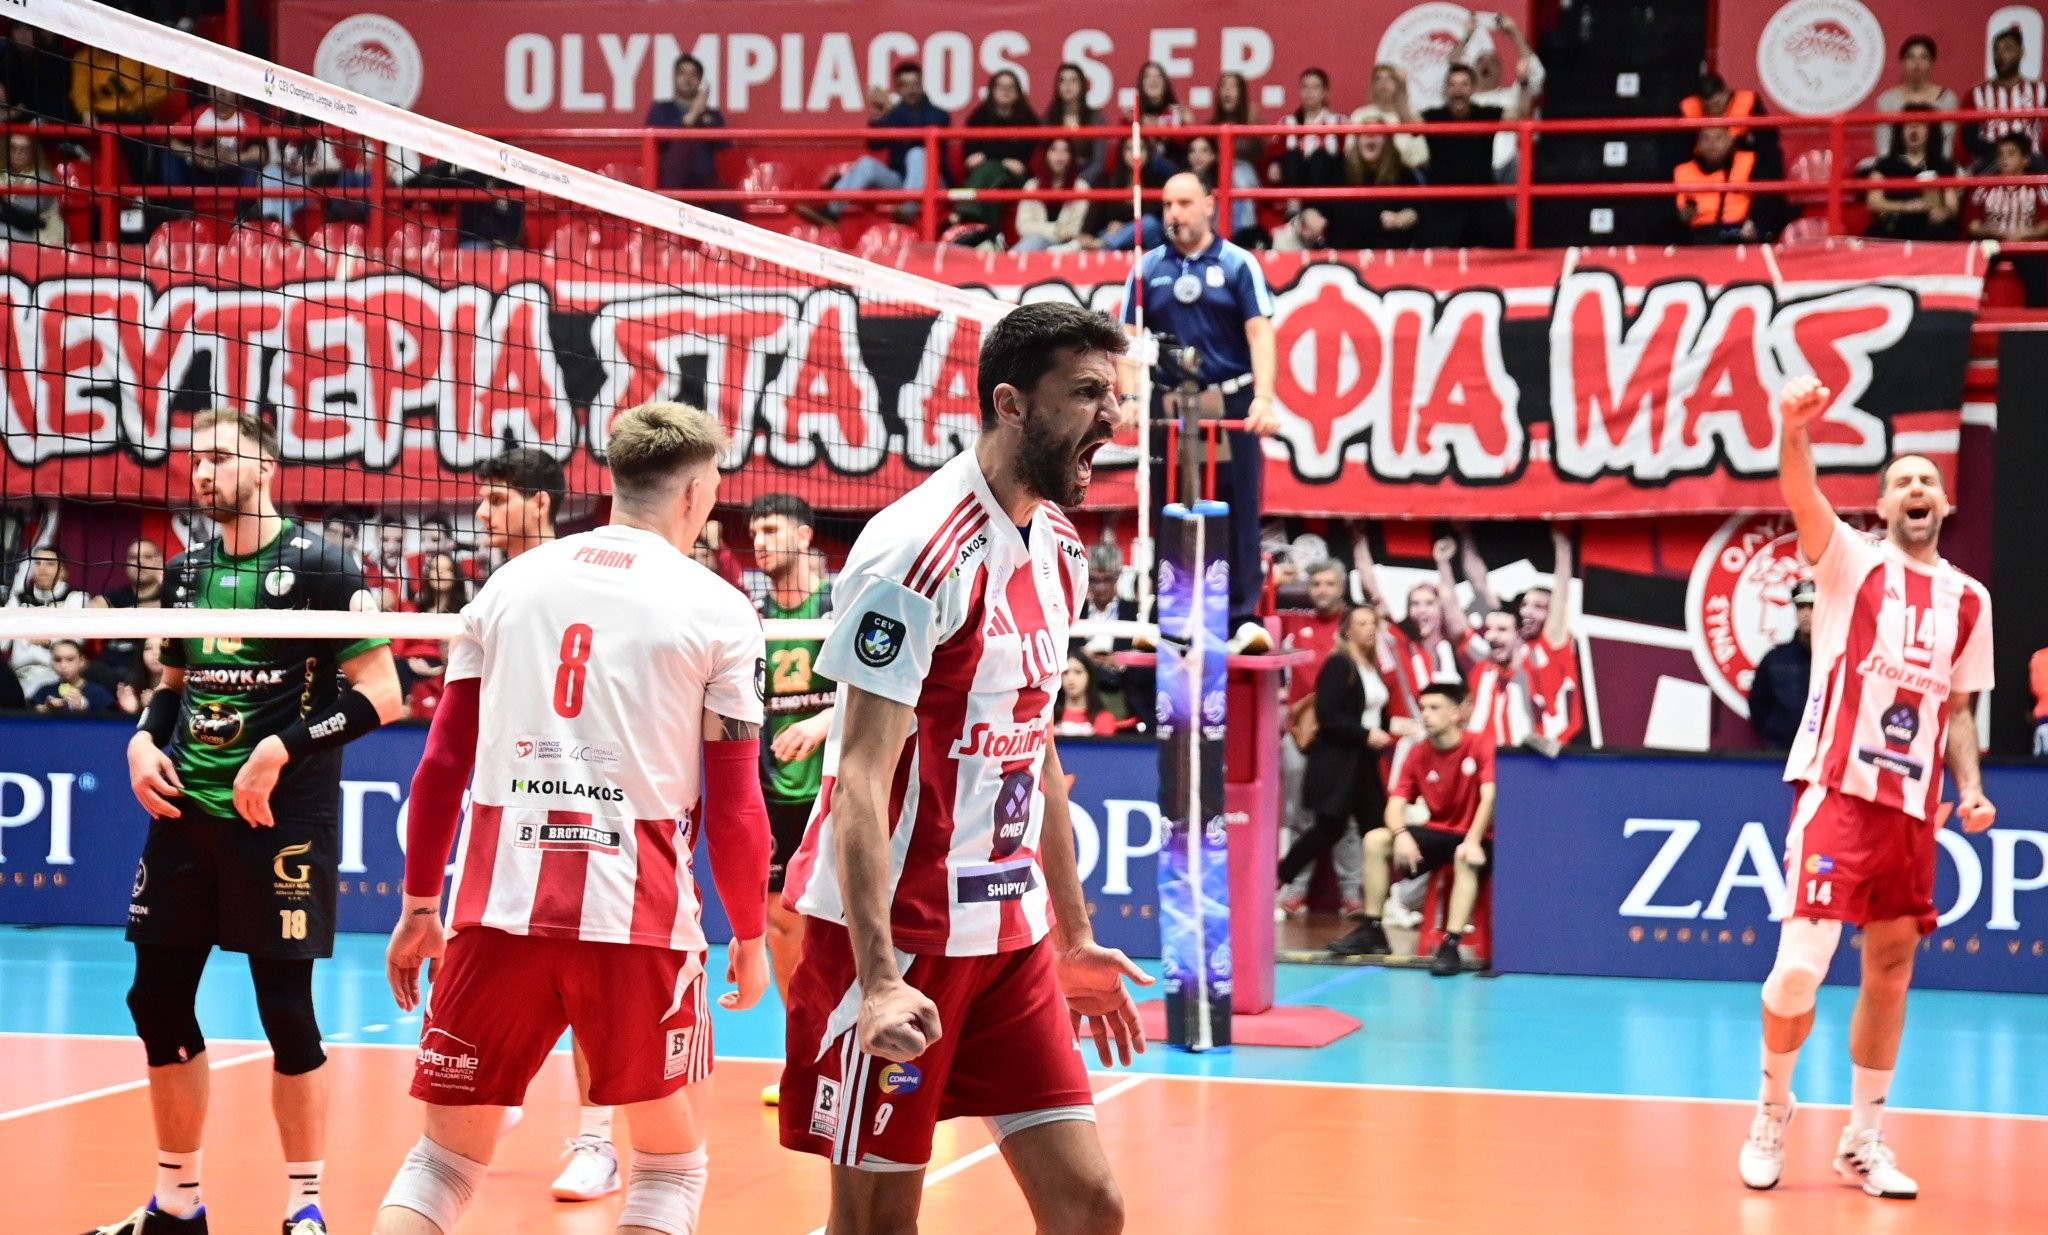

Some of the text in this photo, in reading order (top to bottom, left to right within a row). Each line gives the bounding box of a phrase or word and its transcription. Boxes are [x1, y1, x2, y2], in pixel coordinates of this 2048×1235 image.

[505, 31, 1031, 113] OLYMPIACOS
[1551, 269, 1913, 485] ΜΑΣ
[573, 546, 637, 569] PERRIN
[874, 617, 895, 630] CEV
[1905, 604, 1935, 649] 14
[553, 622, 593, 718] 8
[771, 647, 812, 693] 23
[1864, 655, 1949, 698] Stoiximan
[548, 826, 612, 845] BROTHERS
[1000, 821, 1025, 838] ONEX
[987, 881, 1028, 898] SHIPYA
[1806, 879, 1833, 906] 14
[279, 909, 308, 940] 18
[671, 1032, 686, 1057] B
[888, 1075, 919, 1084] COMLINE
[819, 1083, 835, 1111] B
[873, 1102, 894, 1136] 9
